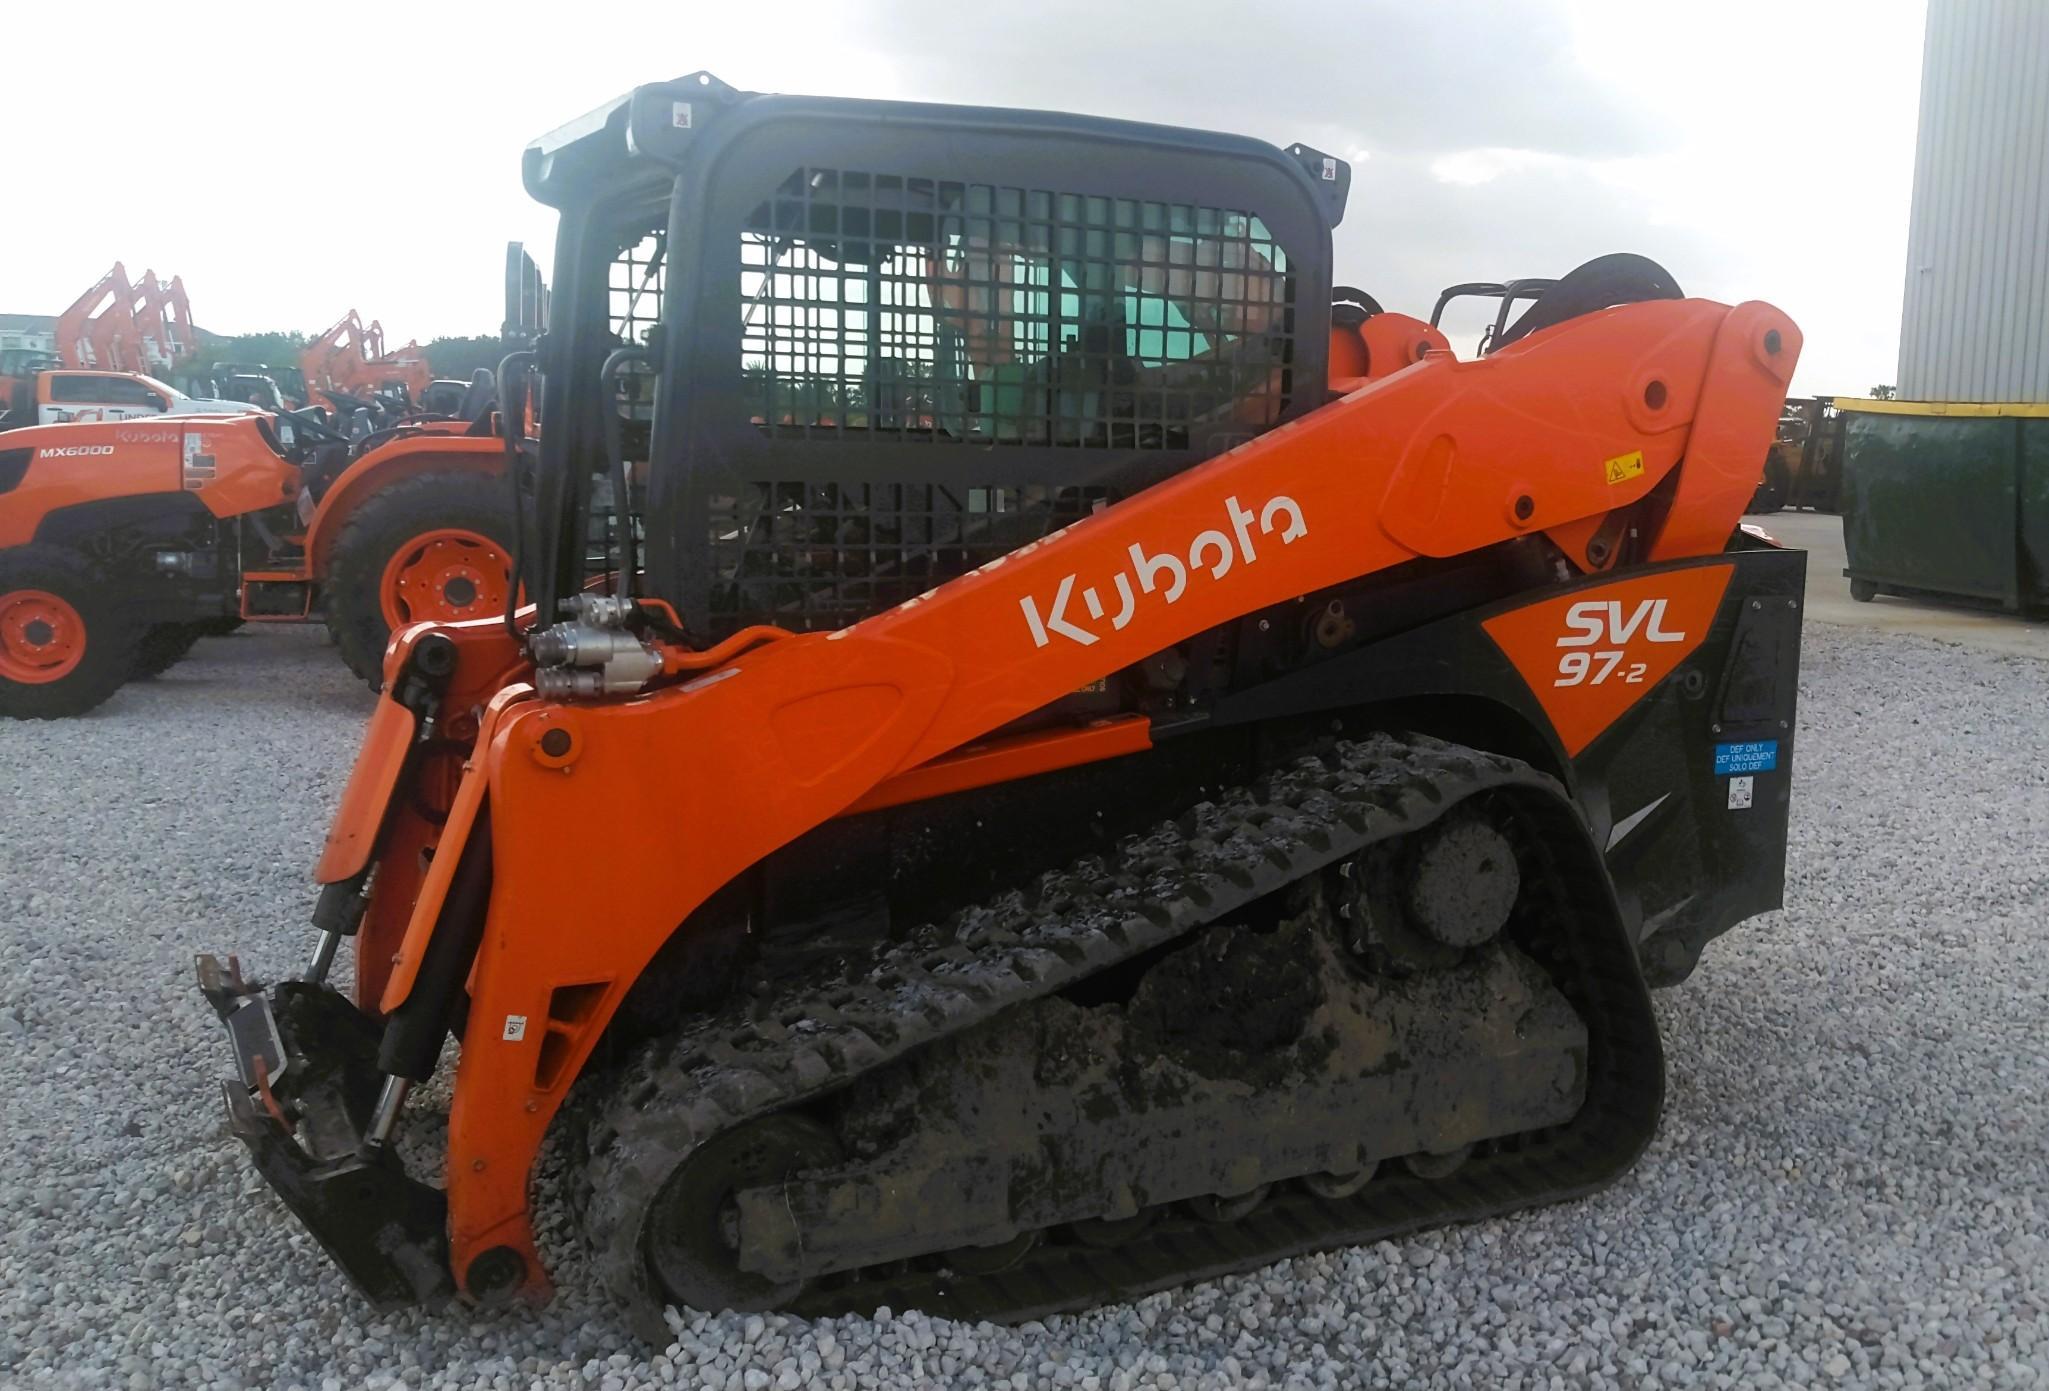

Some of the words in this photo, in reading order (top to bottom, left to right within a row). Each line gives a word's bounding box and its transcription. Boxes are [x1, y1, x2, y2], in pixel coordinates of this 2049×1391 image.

[115, 429, 179, 443] Kubota
[40, 445, 115, 459] MX6000
[1019, 495, 1308, 648] Kubota
[1555, 599, 1686, 648] SVL
[1553, 650, 1647, 688] 97-2
[1730, 745, 1744, 754] DEF
[1746, 744, 1764, 753] ONLY
[1716, 755, 1730, 764] DEF
[1731, 752, 1775, 762] UNIQUEMENT
[1729, 763, 1747, 771] SOLO
[1749, 761, 1763, 770] DEF
